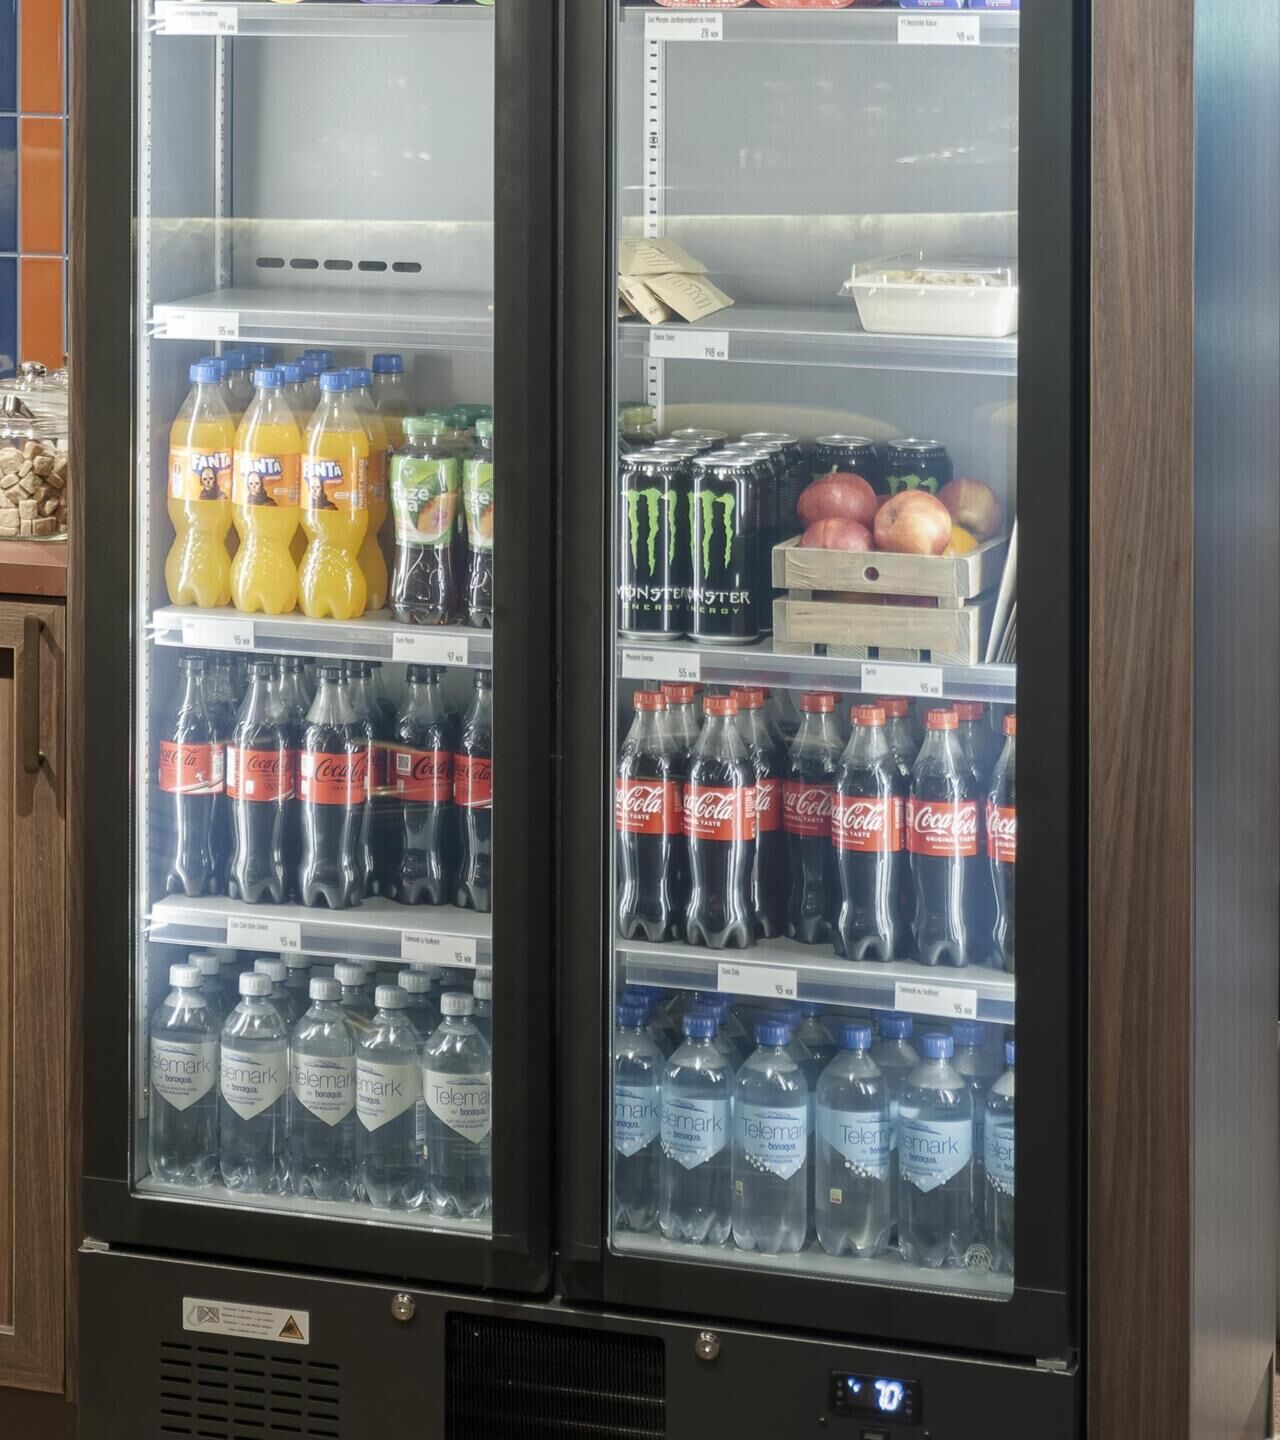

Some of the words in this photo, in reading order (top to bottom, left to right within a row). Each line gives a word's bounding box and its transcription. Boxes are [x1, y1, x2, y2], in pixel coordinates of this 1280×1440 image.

[678, 668, 687, 678] 55
[920, 683, 929, 693] 45
[700, 819, 721, 827] TASTE
[279, 937, 288, 946] 45
[454, 952, 463, 962] 45
[464, 955, 472, 963] NOK
[775, 985, 784, 995] 45
[954, 1004, 963, 1013] 45
